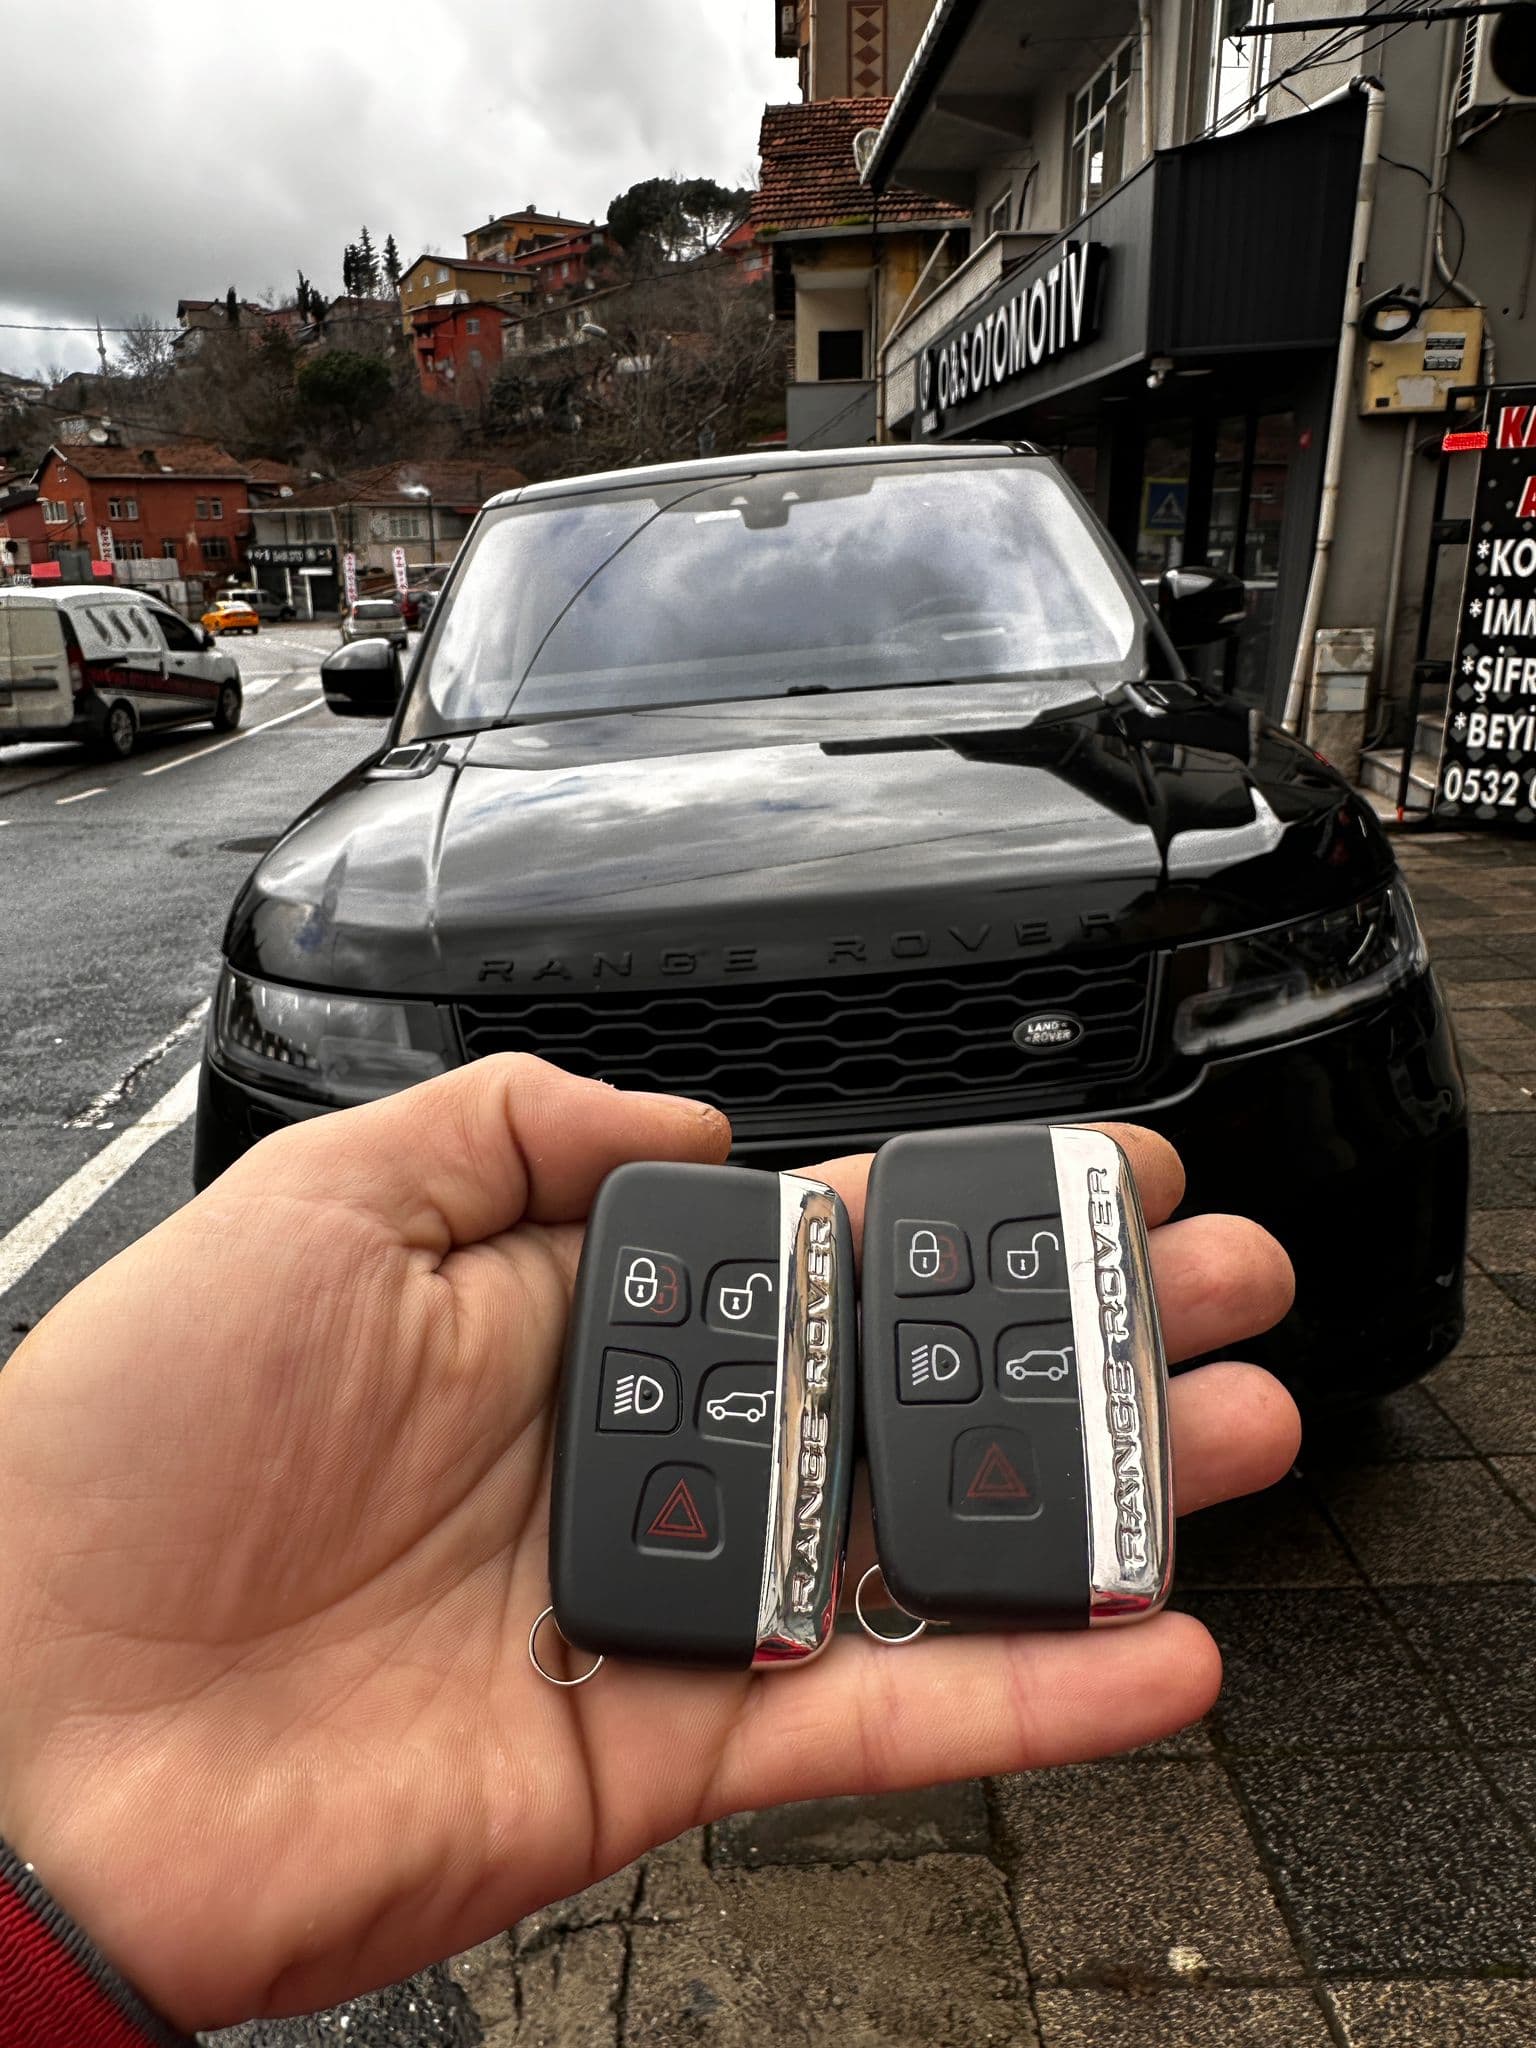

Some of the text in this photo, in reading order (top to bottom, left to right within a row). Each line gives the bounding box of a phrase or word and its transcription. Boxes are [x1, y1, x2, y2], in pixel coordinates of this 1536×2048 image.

[971, 240, 1089, 393] OTOMOTİV
[1444, 766, 1520, 806] 0532
[478, 910, 1120, 982] RANGE ROVER
[1027, 1020, 1060, 1034] LAND
[1031, 1029, 1072, 1044] ROVER
[1086, 1166, 1146, 1566] RANGE ROVER
[792, 1216, 833, 1613] RANGE ROVER
